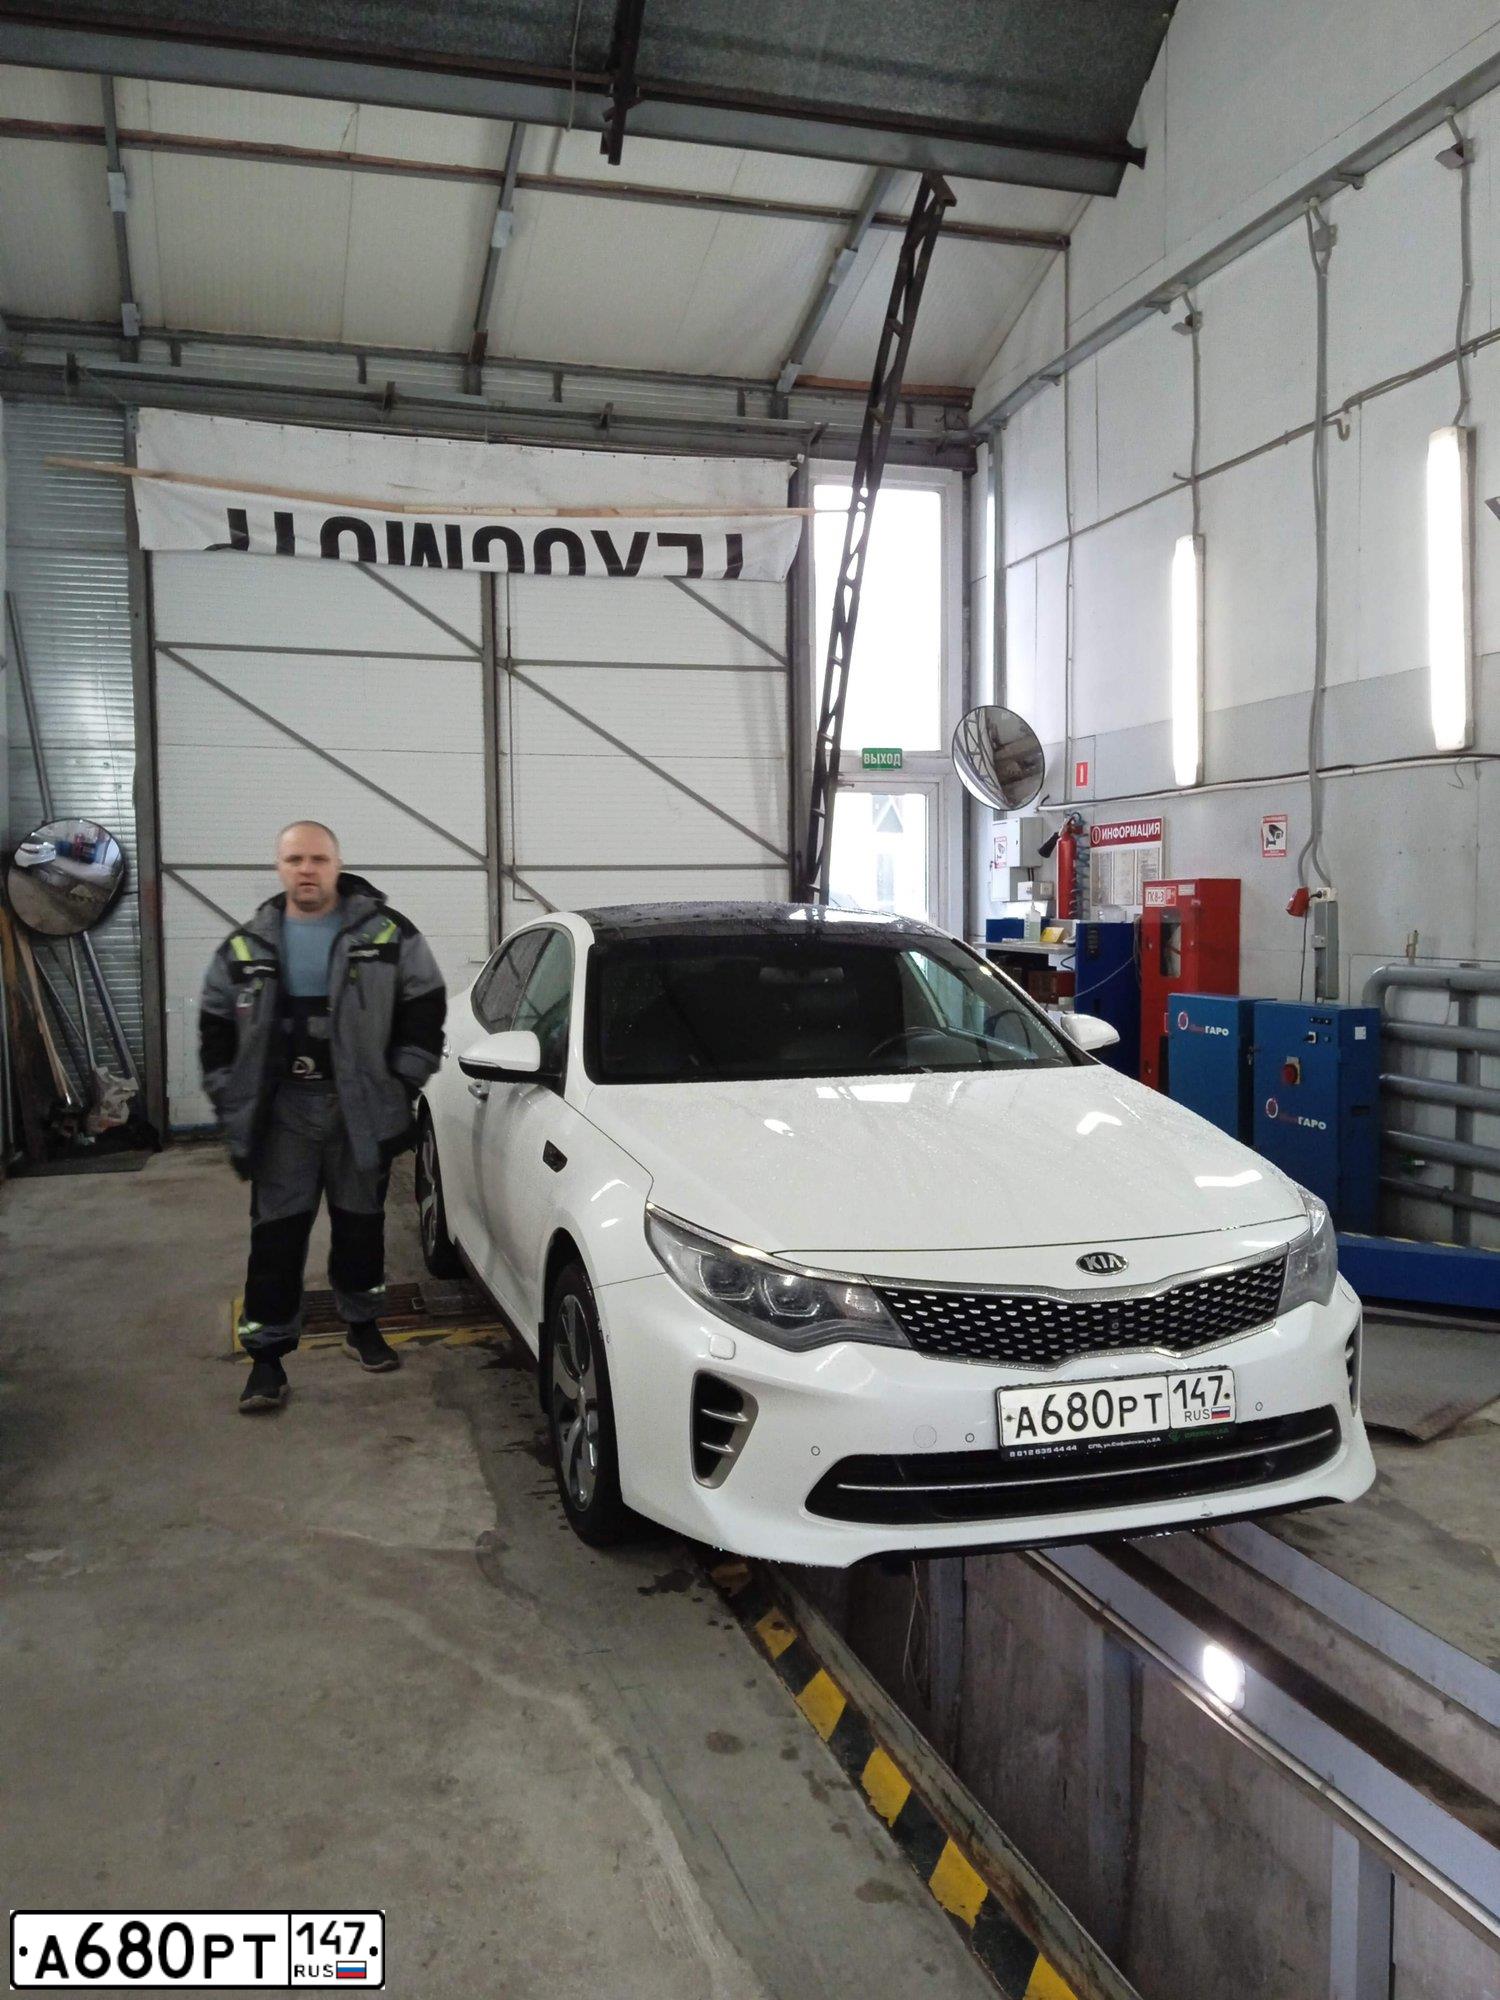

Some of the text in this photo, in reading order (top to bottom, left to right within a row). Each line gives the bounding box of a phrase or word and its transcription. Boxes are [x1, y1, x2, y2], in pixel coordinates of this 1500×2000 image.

[863, 752, 901, 767] ВЫХОД
[1101, 822, 1161, 841] ИНФОРМАЦИЯ
[1204, 1025, 1230, 1037] ГАРО
[1297, 1116, 1327, 1131] ГАРО
[1083, 1254, 1123, 1271] KIA
[1172, 1374, 1224, 1410] 147
[1184, 1408, 1210, 1422] RUS
